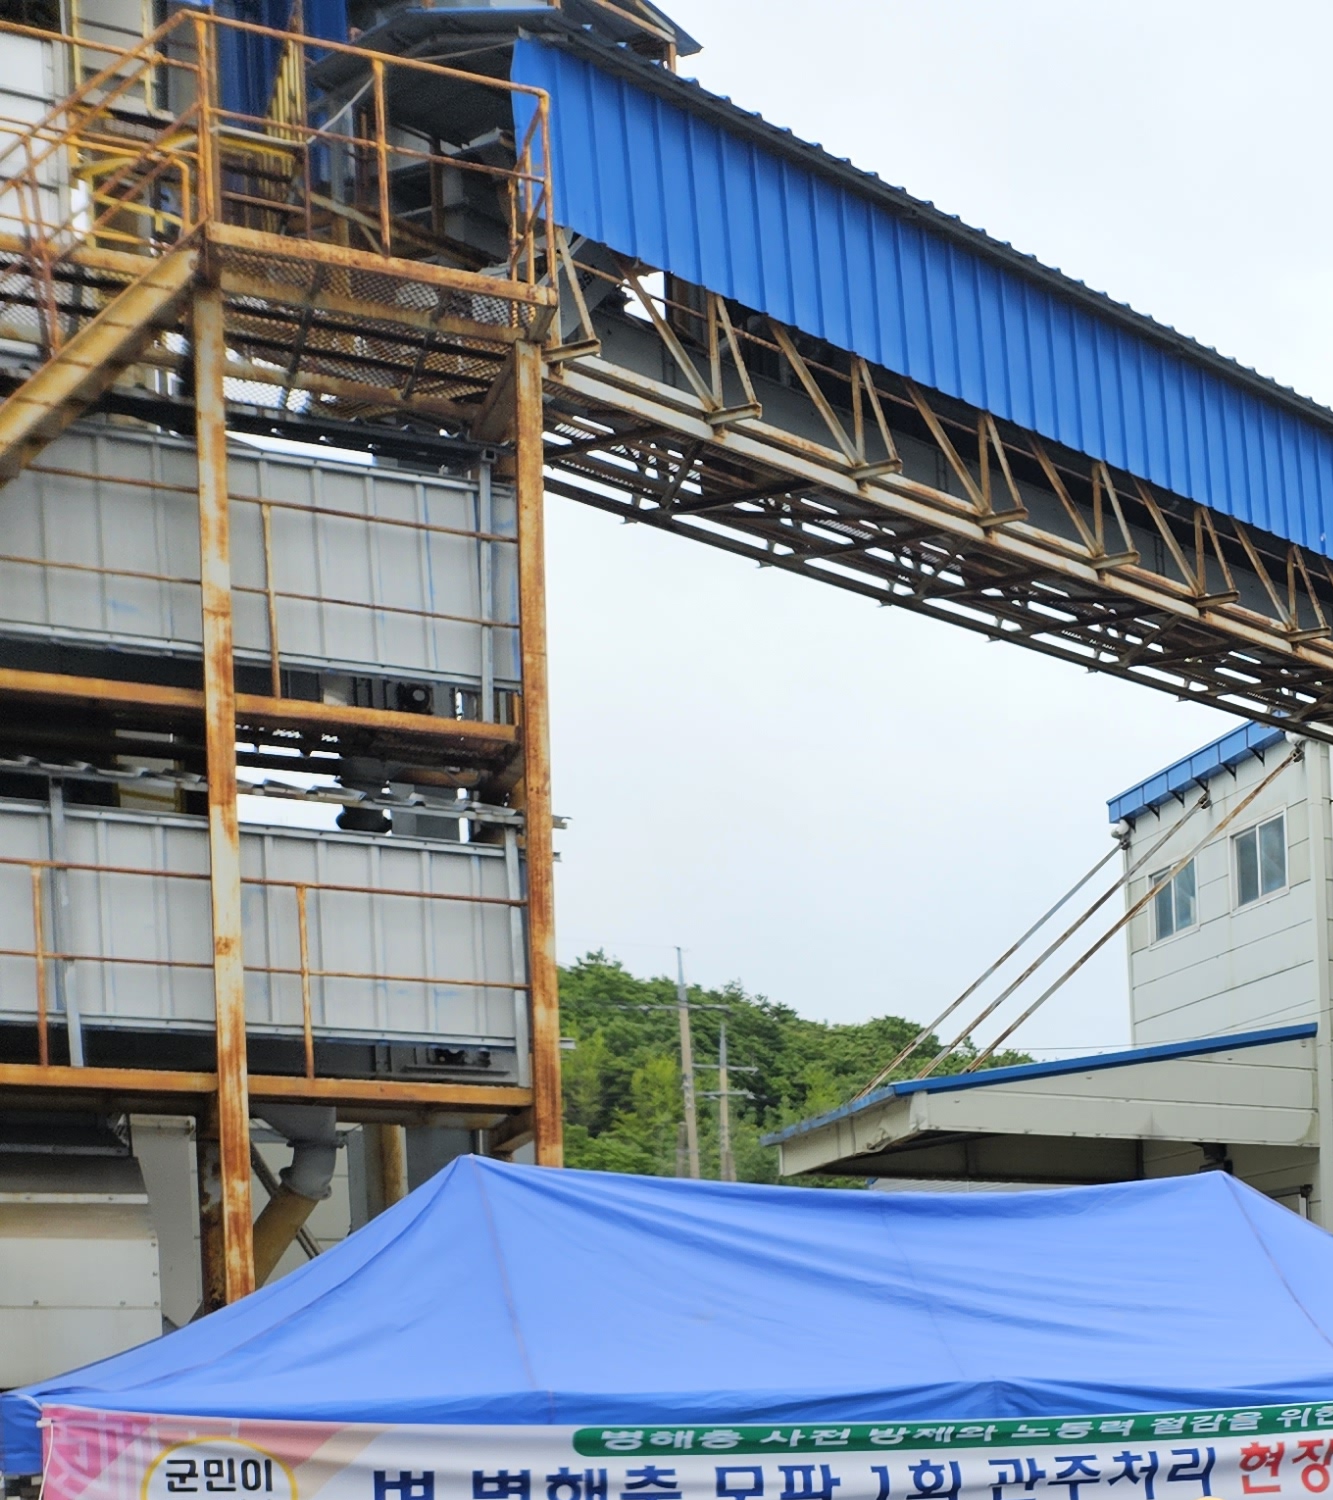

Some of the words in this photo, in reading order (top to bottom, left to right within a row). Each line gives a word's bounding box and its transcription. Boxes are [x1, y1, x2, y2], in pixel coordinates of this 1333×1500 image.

[600, 1429, 743, 1452] 병해충
[760, 1428, 851, 1448] 사전
[868, 1425, 1000, 1446] 방제와
[1010, 1418, 1133, 1440] 노동력
[1150, 1411, 1263, 1435] 절감을
[166, 1457, 273, 1493] 군민이
